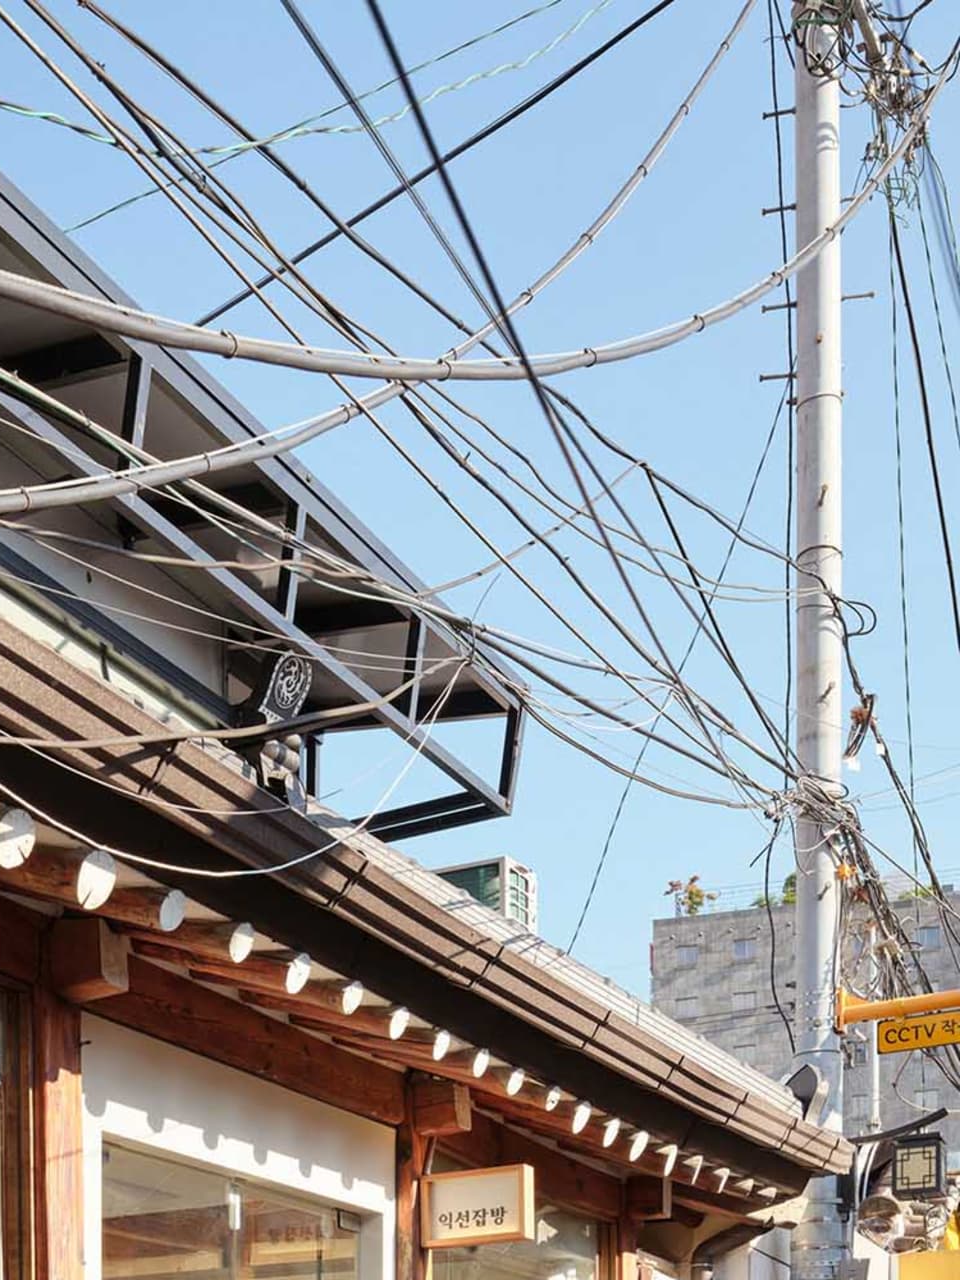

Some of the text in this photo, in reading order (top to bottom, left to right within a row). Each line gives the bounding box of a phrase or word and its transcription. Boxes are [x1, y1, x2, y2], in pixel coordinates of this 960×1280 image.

[884, 1019, 960, 1044] CCTV 작
[438, 1206, 507, 1229] 익선잡방
